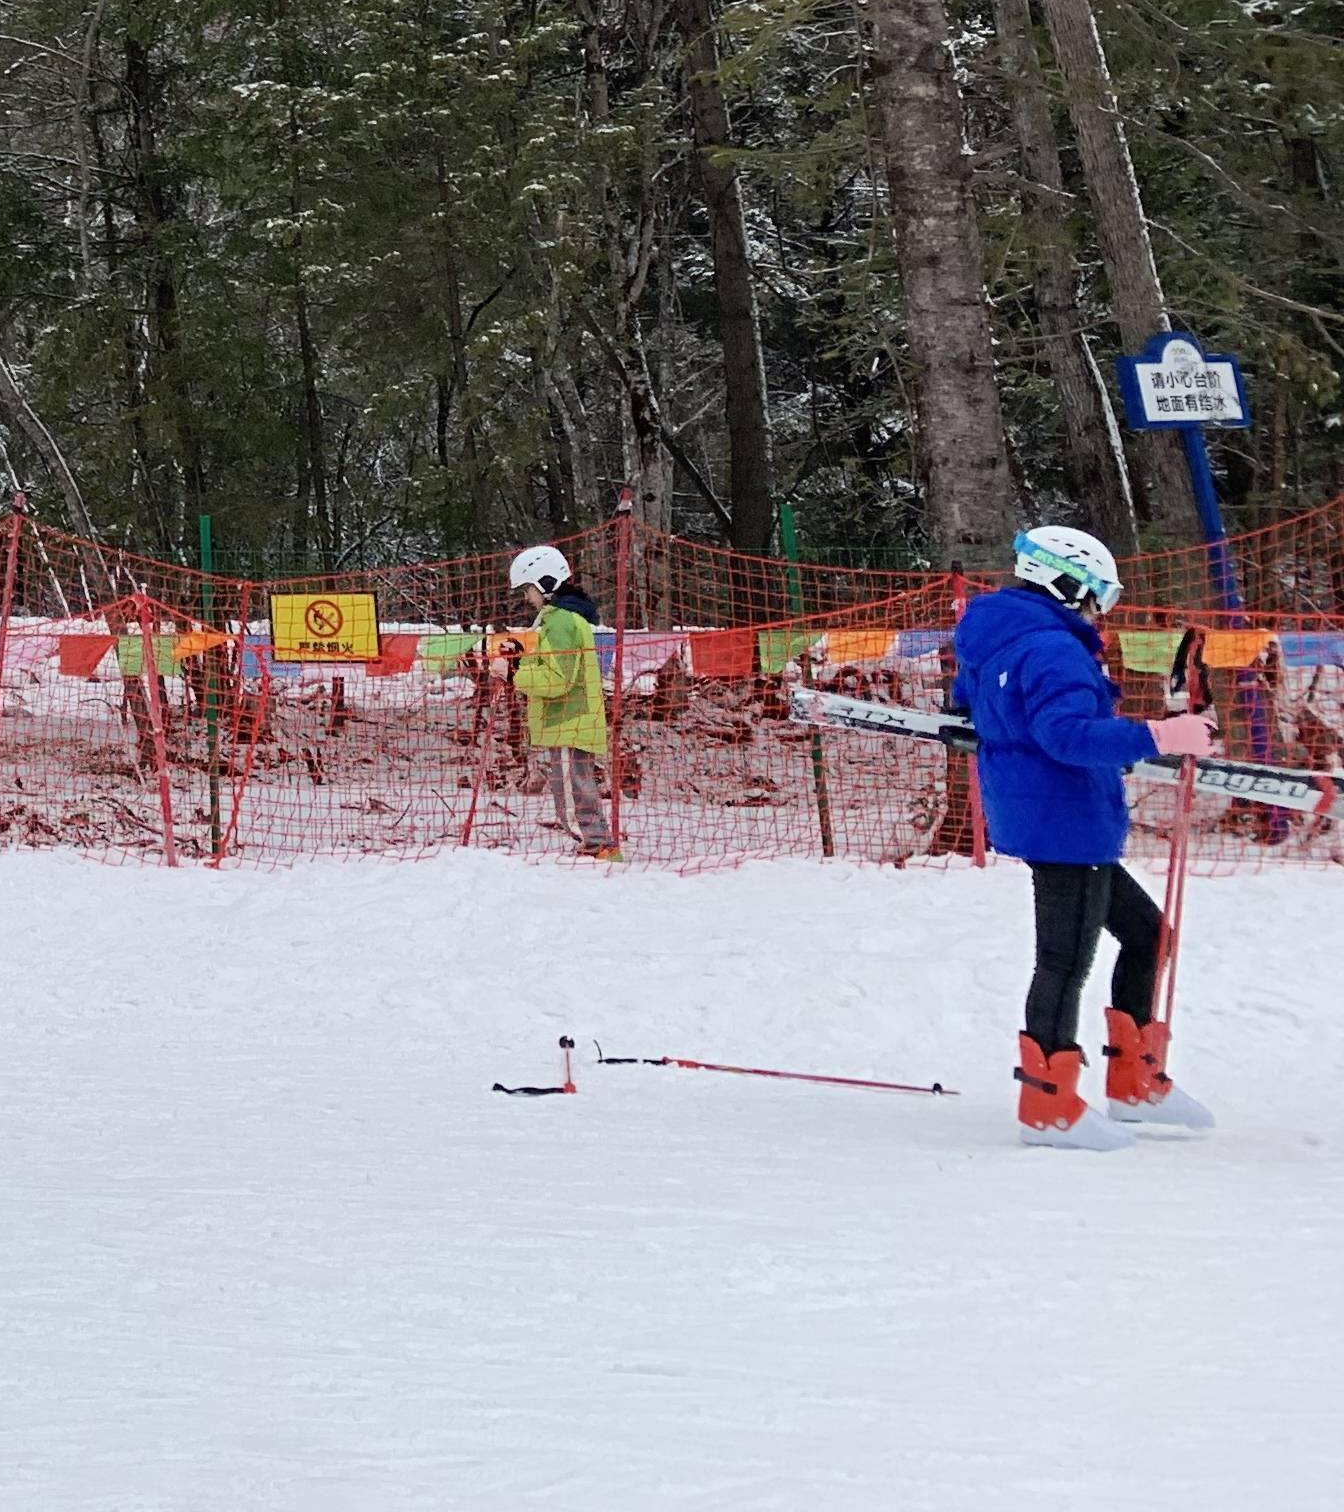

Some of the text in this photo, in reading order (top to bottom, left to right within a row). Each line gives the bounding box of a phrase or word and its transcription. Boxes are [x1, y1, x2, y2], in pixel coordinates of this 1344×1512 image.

[1151, 371, 1221, 389] 请小心台阶
[1156, 394, 1227, 412] 地面有结冰
